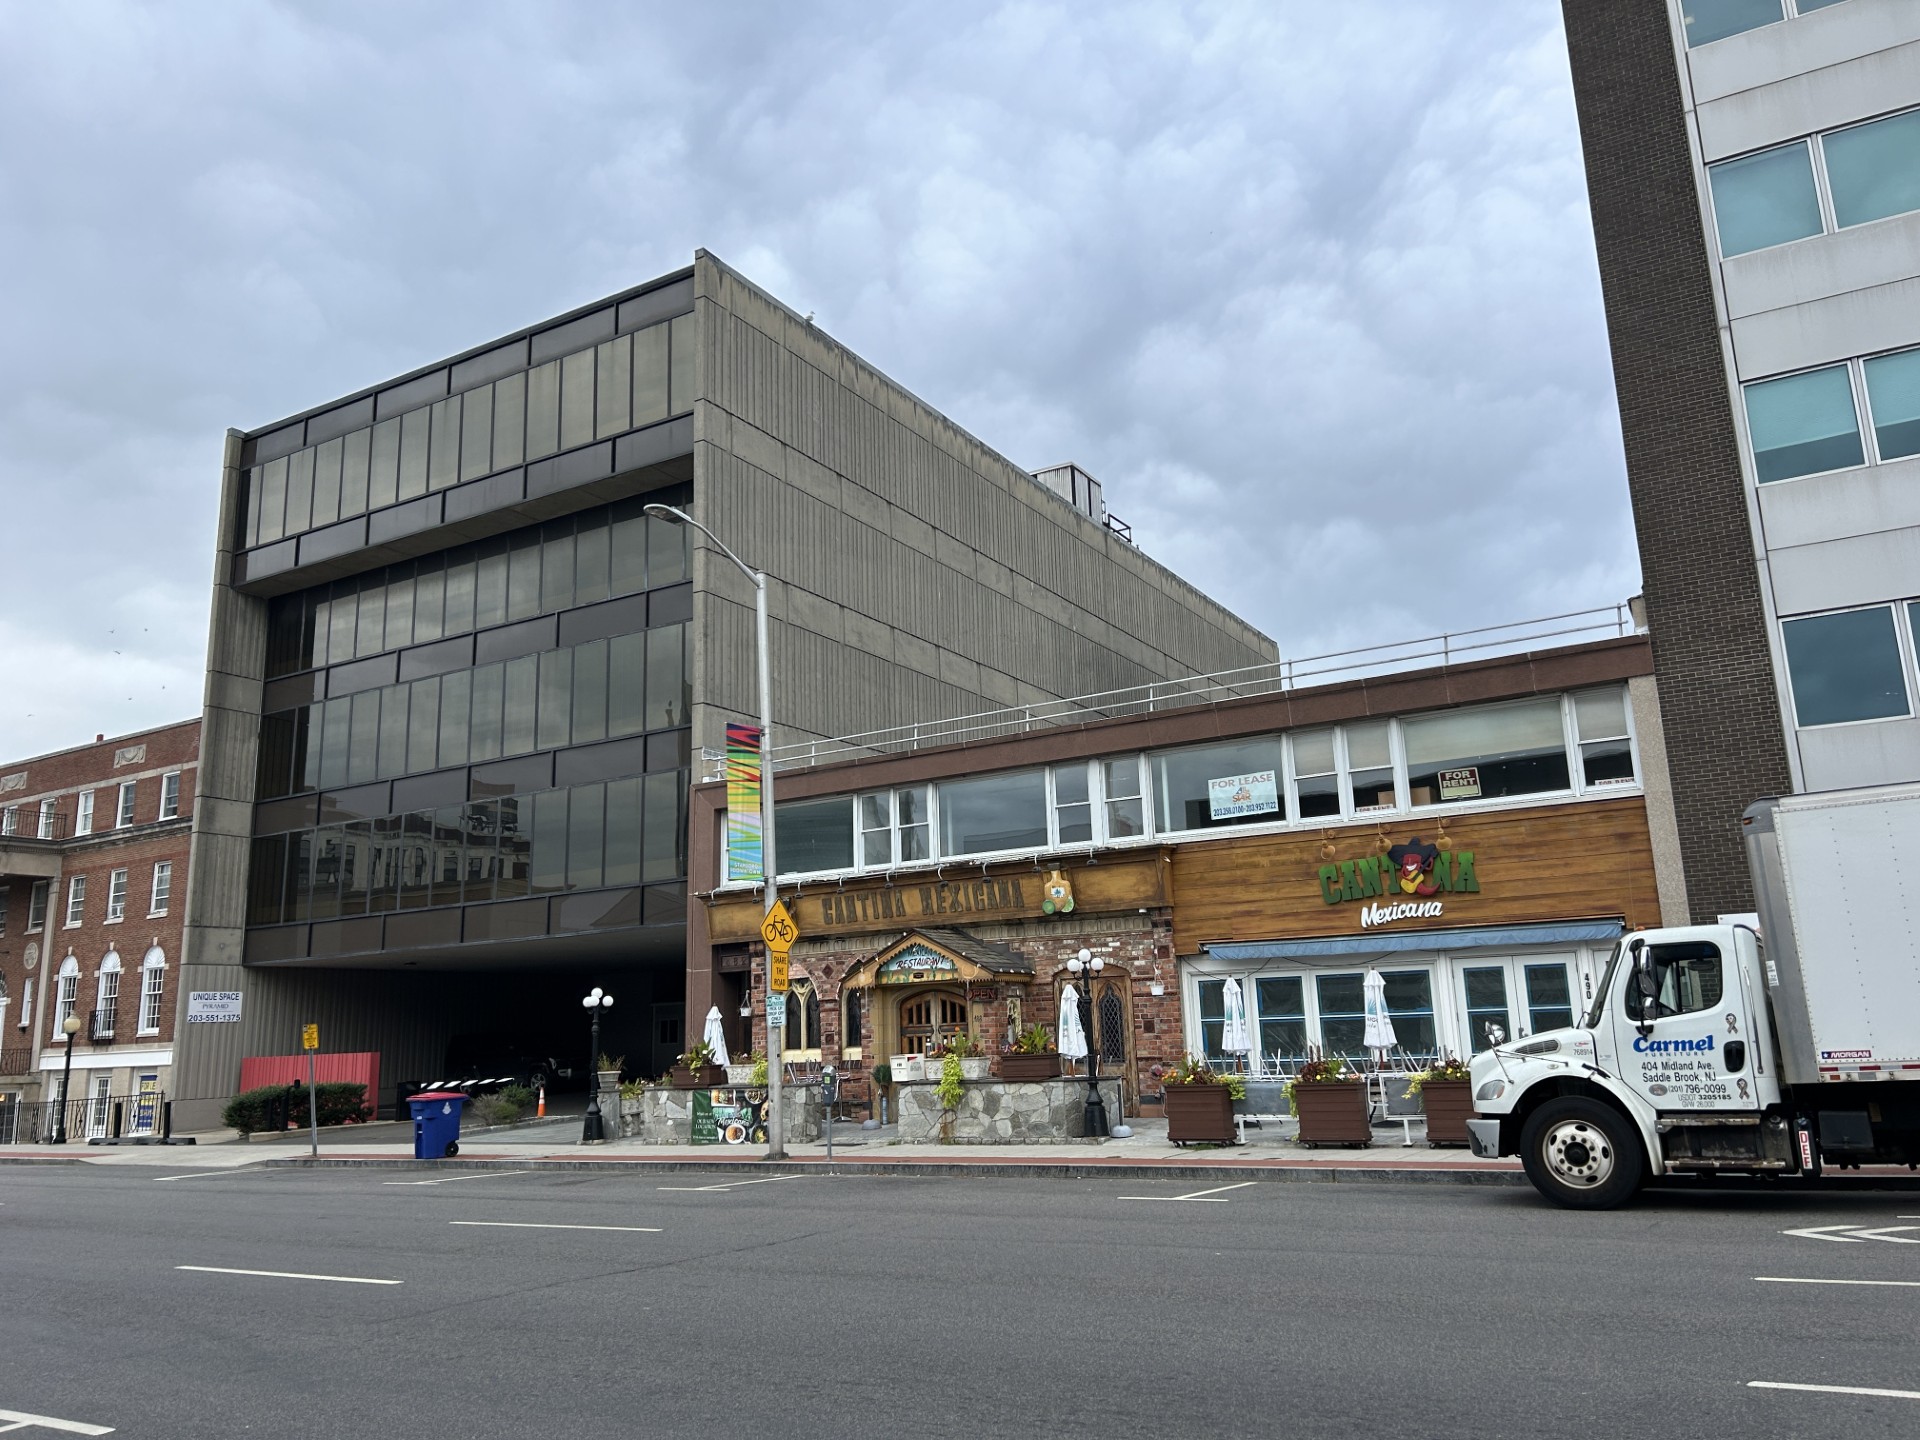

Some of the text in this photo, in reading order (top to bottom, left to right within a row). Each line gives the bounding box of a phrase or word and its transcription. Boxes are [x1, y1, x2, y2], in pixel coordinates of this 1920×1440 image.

[1445, 771, 1471, 780] FOR
[1211, 773, 1273, 790] FOR LEASE
[1443, 778, 1476, 788] RENT
[1319, 851, 1480, 904] CANTNA
[821, 878, 1025, 925] CANTINA MEXICANA
[1361, 901, 1443, 928] Mexicana
[773, 956, 787, 965] SHARE
[896, 956, 944, 970] RESTAURANT
[776, 967, 784, 976] THE
[774, 978, 786, 987] ROAD
[193, 993, 239, 1001] UNIQUE SPACE
[965, 988, 995, 1000] OPEN
[188, 1014, 241, 1022] 203-551-1375
[1633, 1034, 1715, 1053] Carmel
[1831, 1050, 1870, 1059] MORGAN
[1642, 1060, 1715, 1071] 404 Midland Ave.
[1643, 1071, 1717, 1083] Saddle Brook, NJ
[1668, 1084, 1684, 1093] (201)
[1685, 1083, 1727, 1094] 796-0099
[1800, 1132, 1811, 1168] DEF
